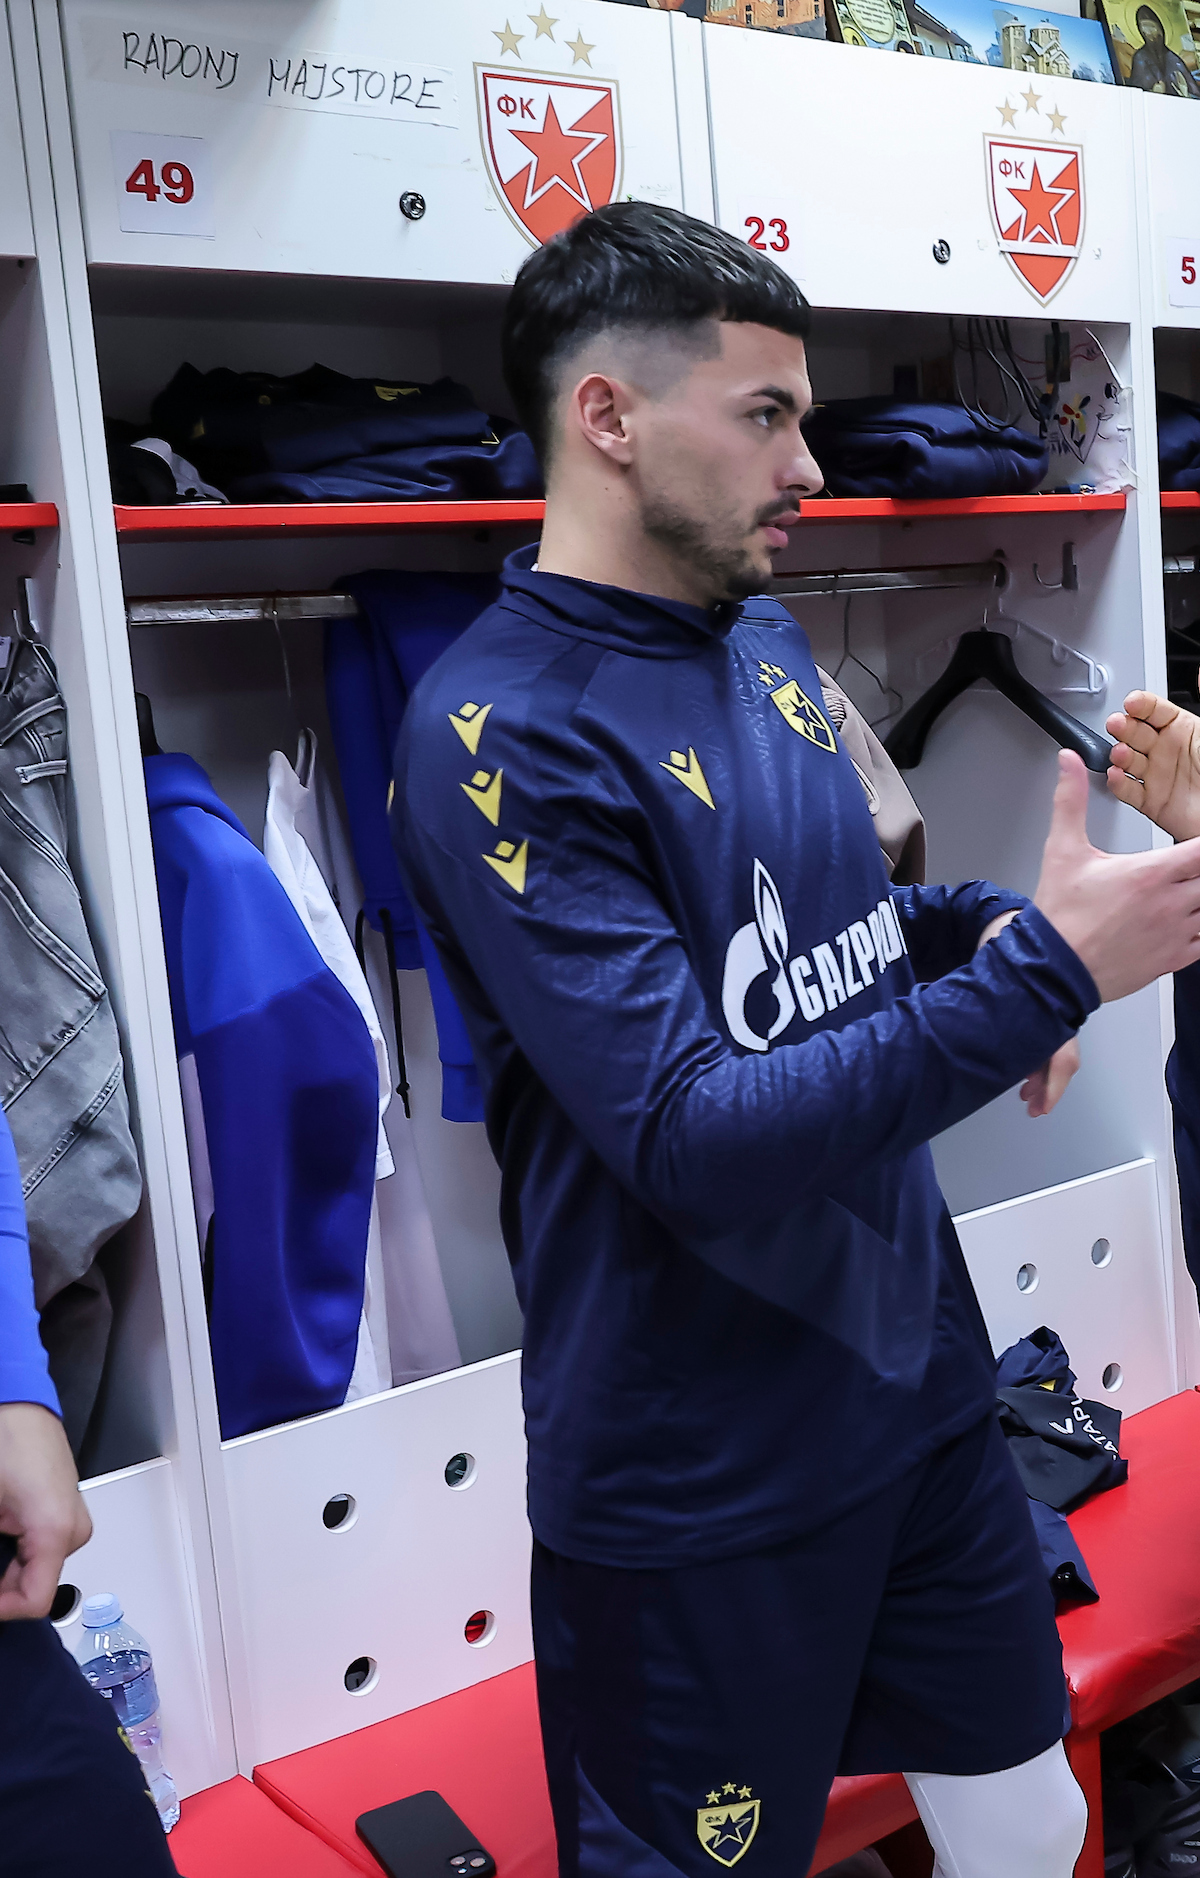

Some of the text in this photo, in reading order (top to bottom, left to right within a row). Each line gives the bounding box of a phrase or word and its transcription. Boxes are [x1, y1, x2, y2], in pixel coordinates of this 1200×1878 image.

[122, 31, 444, 110] RADONJ MAJSTORE
[497, 93, 537, 120] ФК
[126, 159, 194, 204] 49
[998, 158, 1026, 180] ФК
[744, 216, 790, 252] 23
[1181, 256, 1197, 285] 5
[788, 893, 909, 1023] GAZPRO
